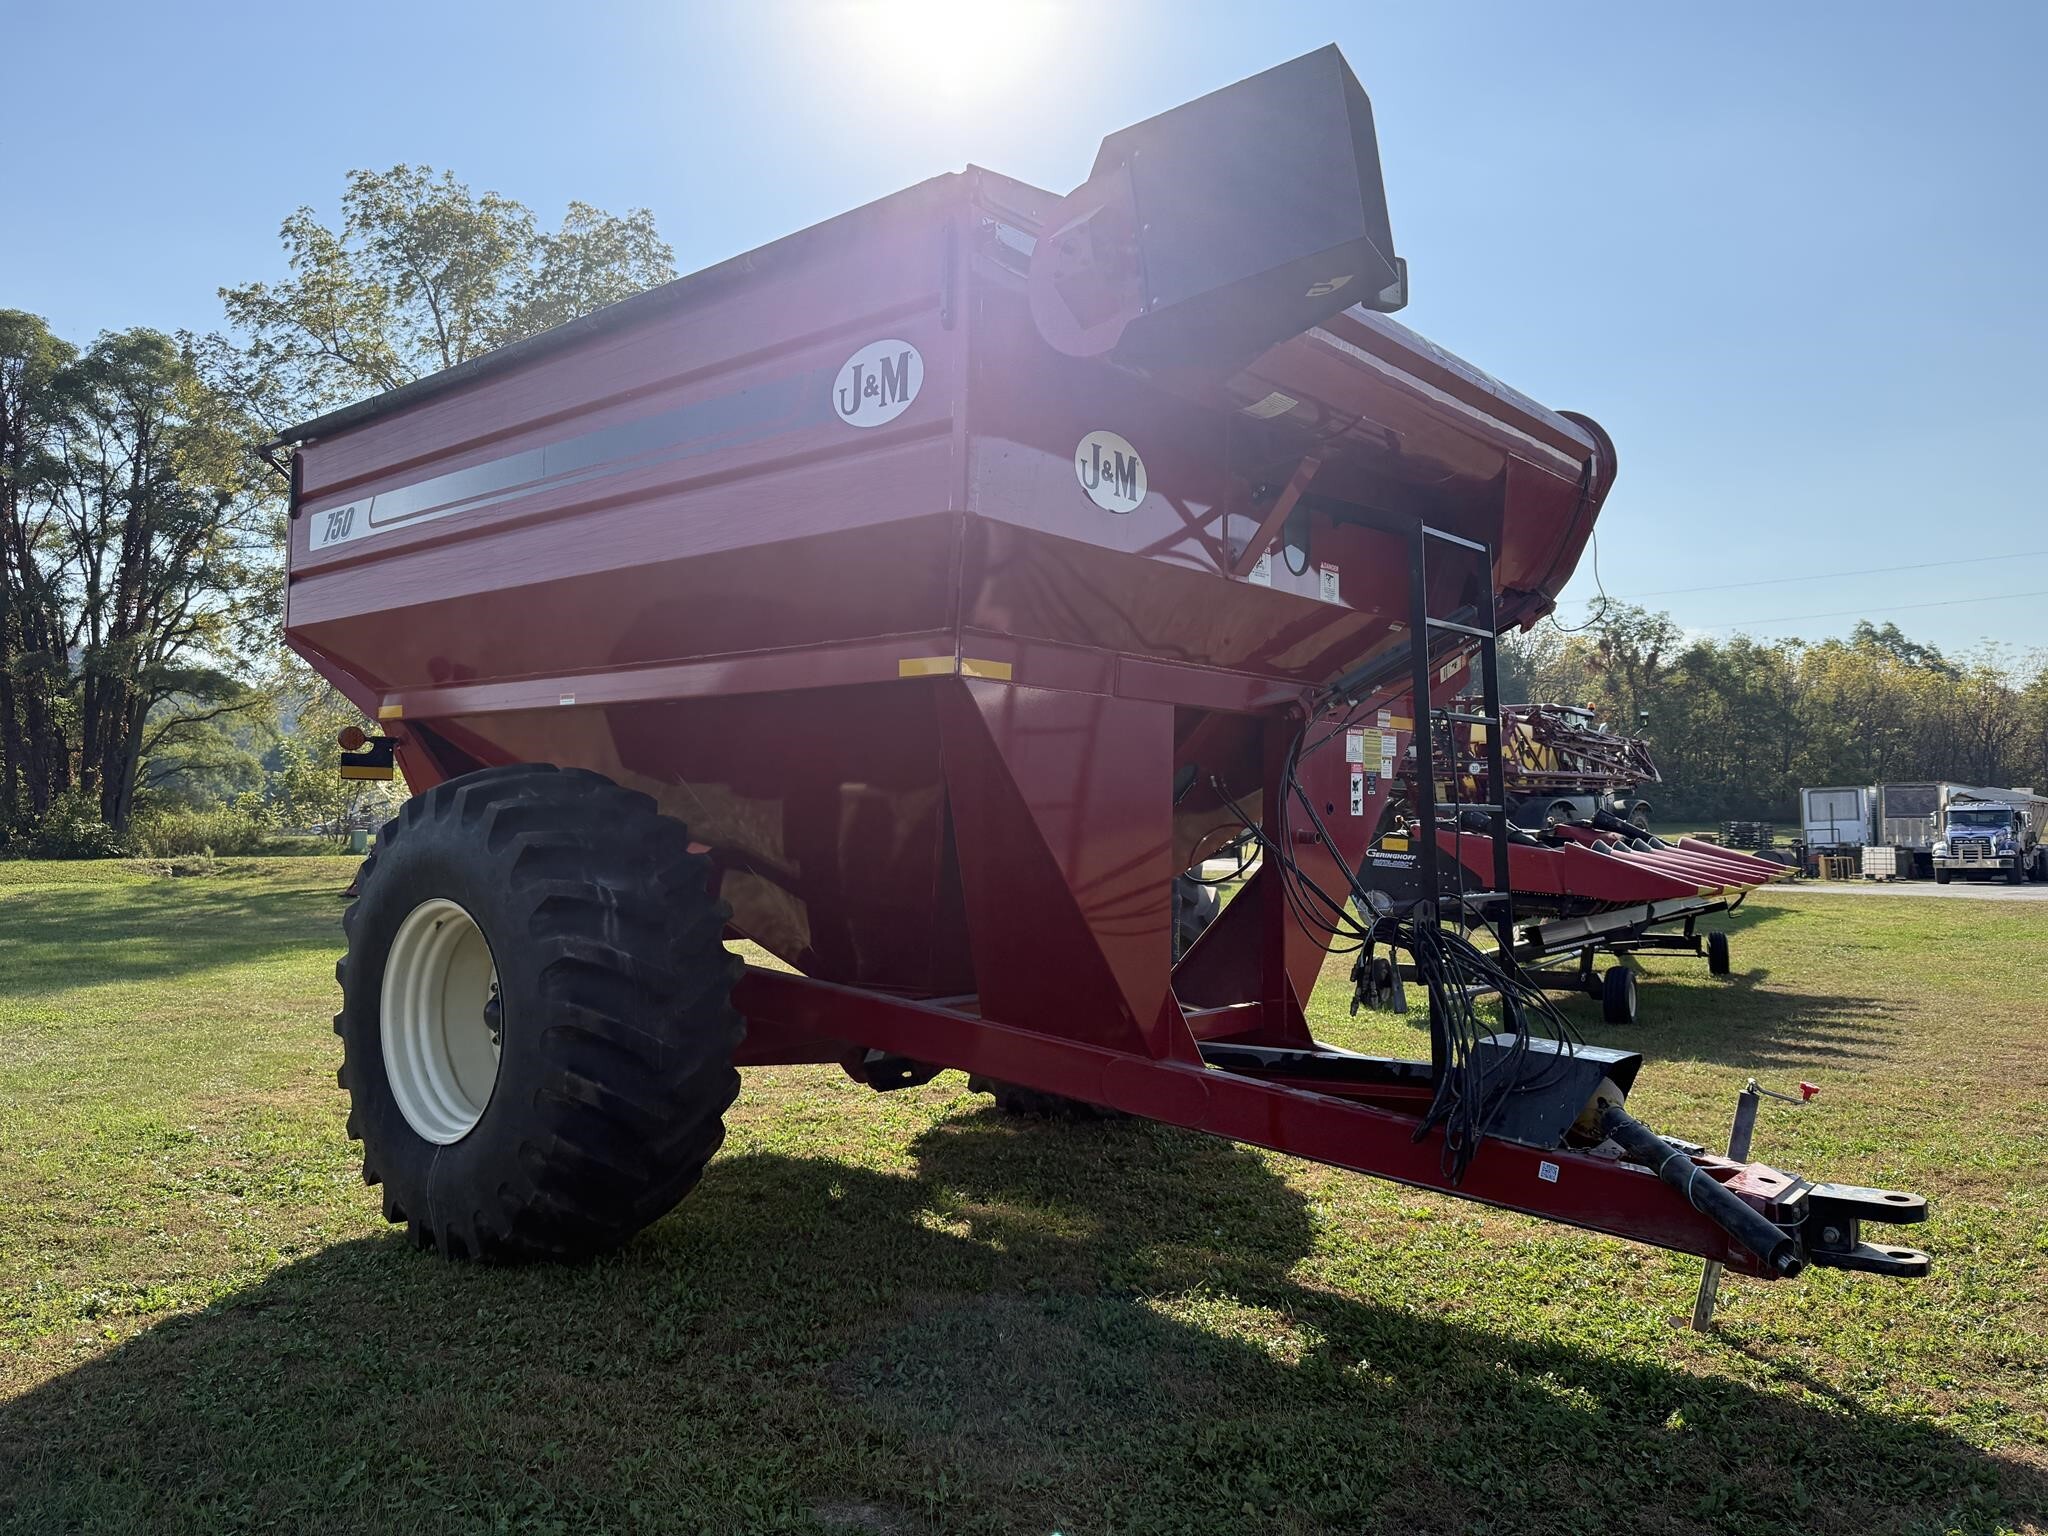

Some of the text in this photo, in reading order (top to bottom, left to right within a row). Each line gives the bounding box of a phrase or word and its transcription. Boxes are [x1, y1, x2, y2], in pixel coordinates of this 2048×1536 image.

[838, 350, 911, 416] J&M
[1080, 442, 1137, 502] J&M
[322, 506, 355, 543] 750
[1365, 848, 1417, 861] GERINGHOFF
